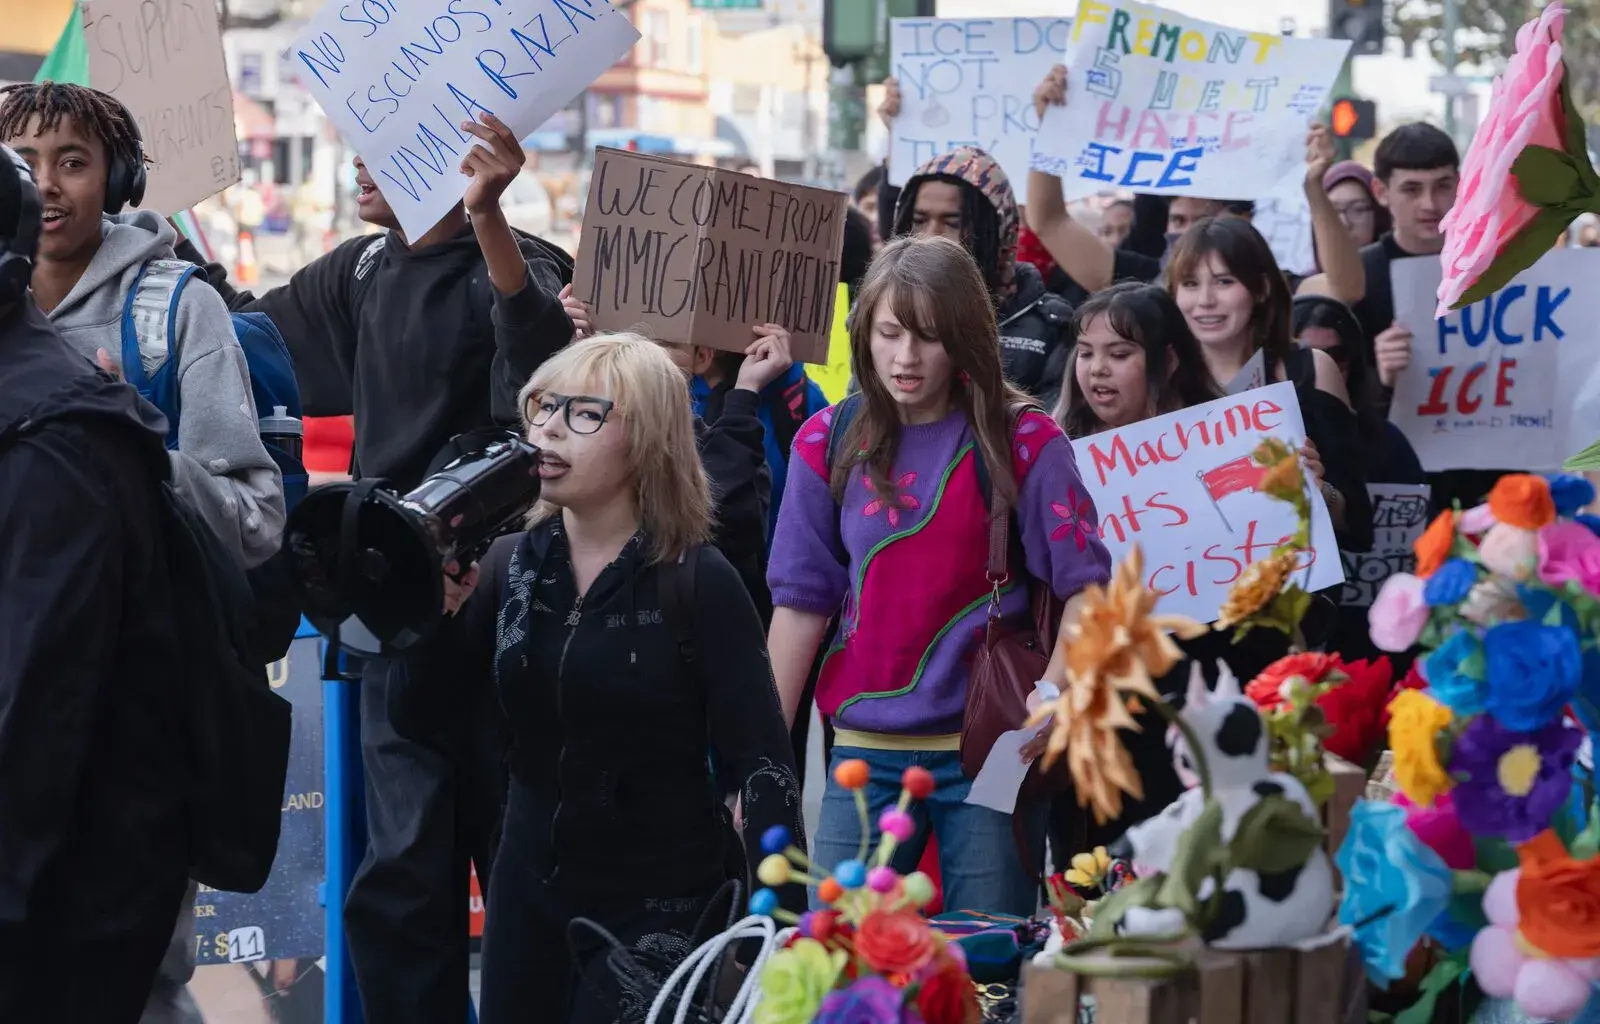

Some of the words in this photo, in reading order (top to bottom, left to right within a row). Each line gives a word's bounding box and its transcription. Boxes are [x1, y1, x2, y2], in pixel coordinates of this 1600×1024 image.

[297, 31, 346, 89] NO
[897, 20, 995, 57] ICE
[1071, 0, 1283, 64] FREMONT
[380, 122, 459, 202] VIVA
[432, 82, 495, 144] LA
[475, 0, 616, 100] RAZA
[897, 58, 1000, 100] NOT
[1094, 101, 1255, 150] HATE
[1079, 142, 1204, 188] ICE
[598, 160, 667, 217] WE
[667, 173, 761, 233] COME
[765, 189, 836, 245] FROM
[584, 224, 764, 324] IMMIGRANT
[1436, 284, 1571, 354] FUCK
[1416, 356, 1518, 416] ICE
[1088, 400, 1284, 487] Machine
[1097, 491, 1189, 543] nts
[1148, 520, 1318, 597] cists
